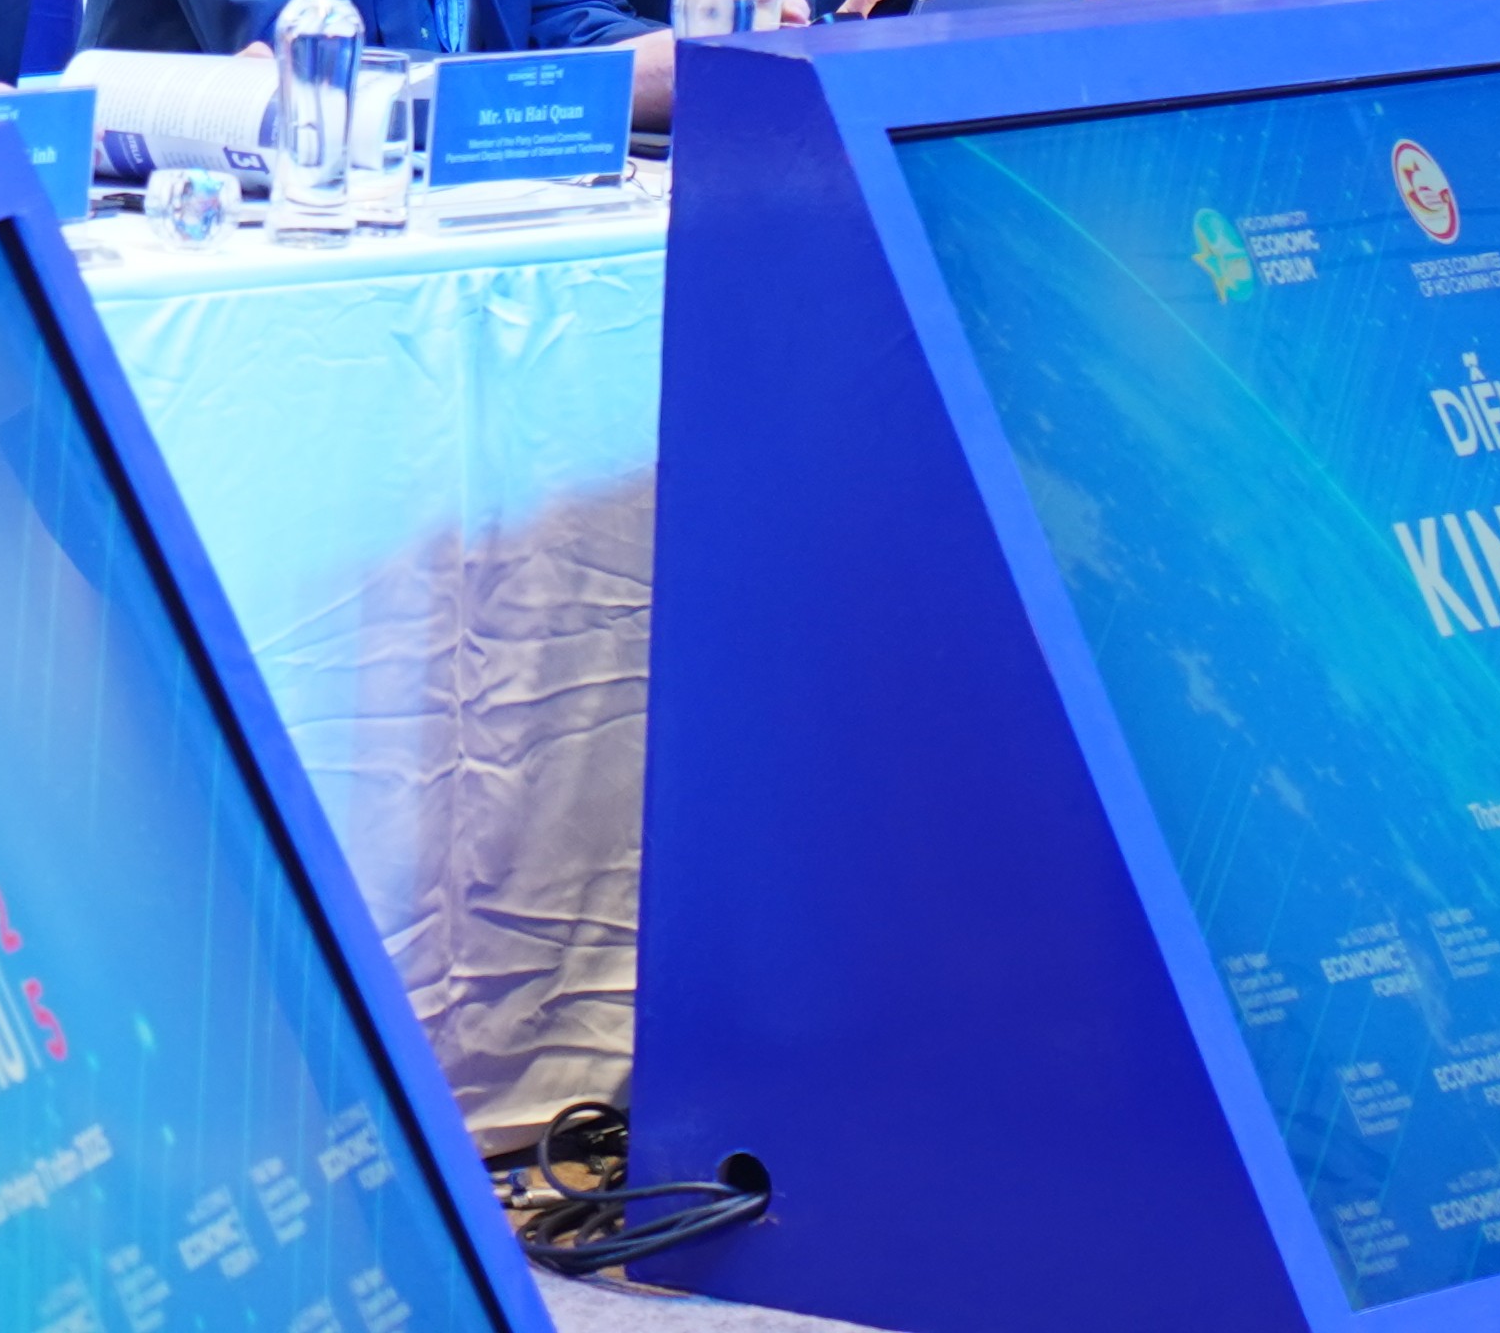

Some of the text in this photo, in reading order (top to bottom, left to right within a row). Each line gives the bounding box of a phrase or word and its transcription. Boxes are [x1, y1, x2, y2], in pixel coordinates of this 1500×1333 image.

[479, 104, 584, 126] Mr. Vu Hai Quan
[1249, 230, 1320, 258] ECONOMIC
[1260, 256, 1319, 285] FORUM
